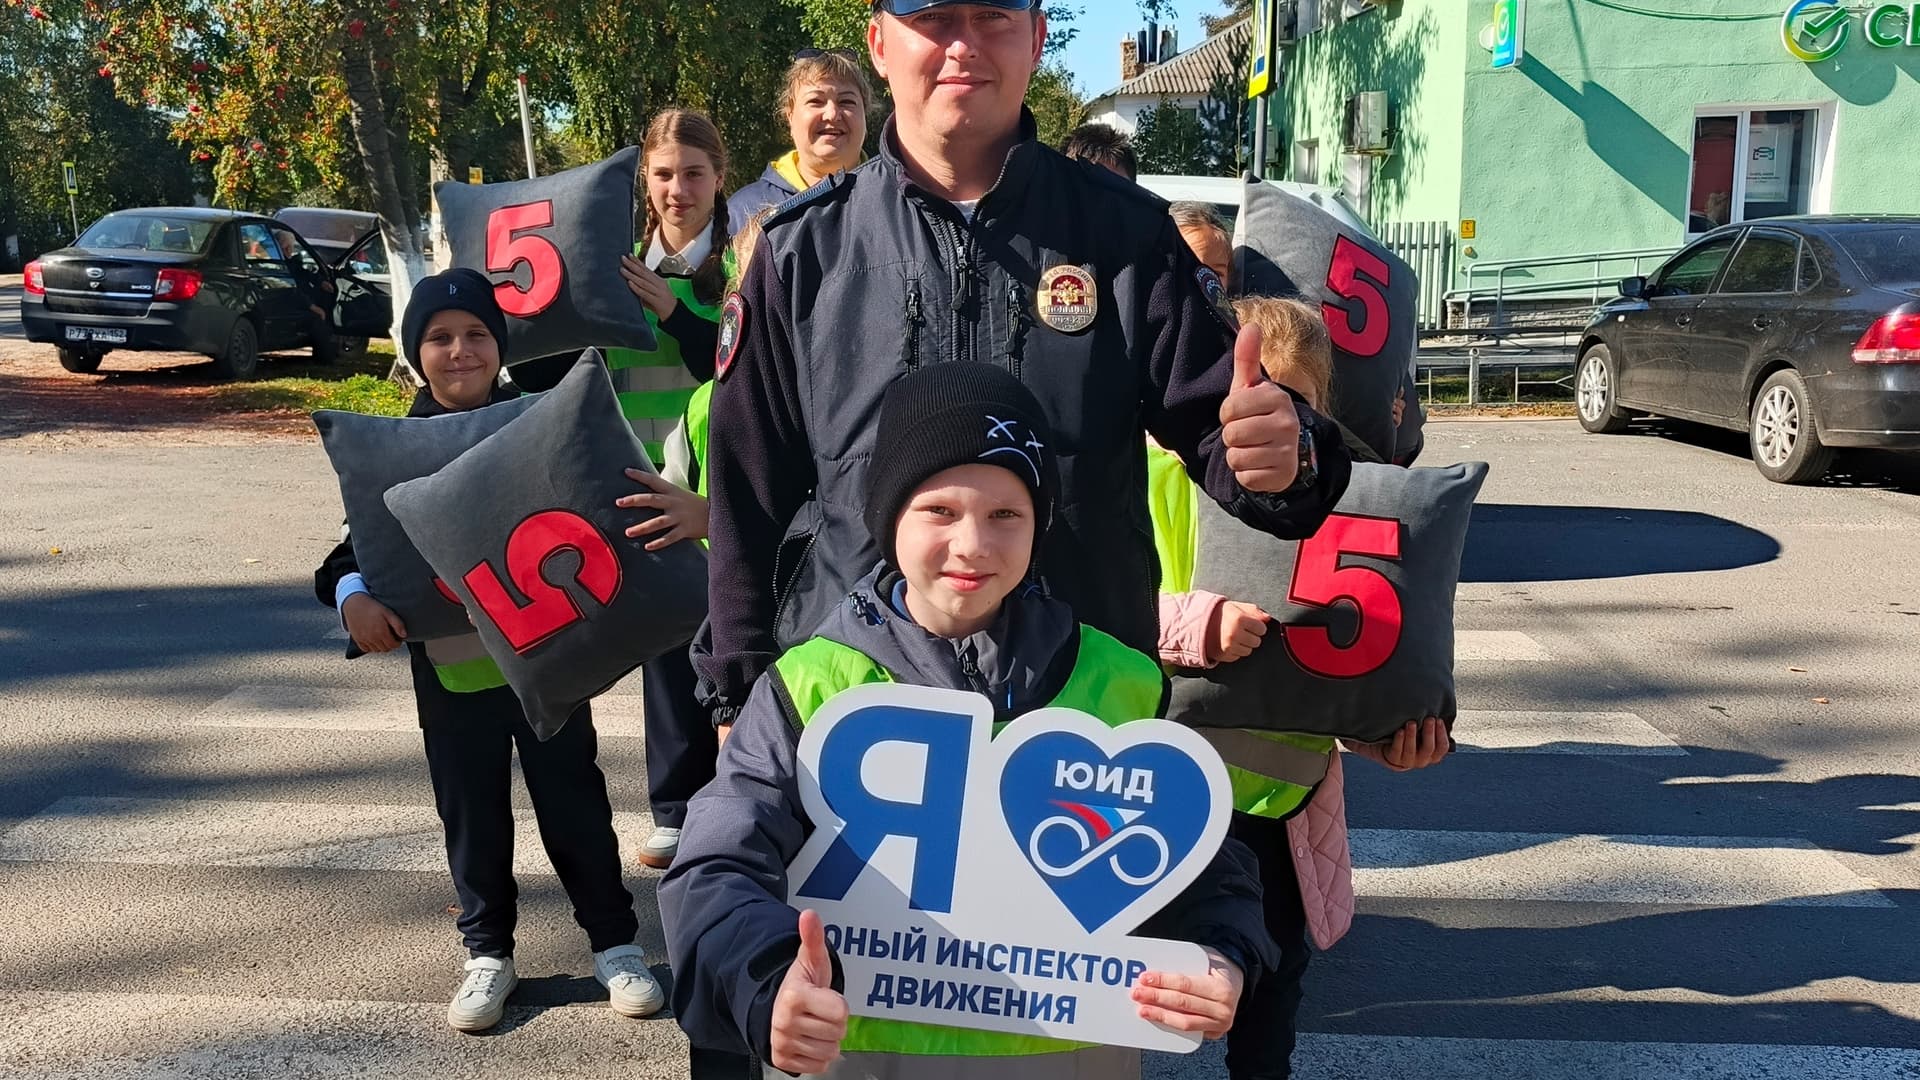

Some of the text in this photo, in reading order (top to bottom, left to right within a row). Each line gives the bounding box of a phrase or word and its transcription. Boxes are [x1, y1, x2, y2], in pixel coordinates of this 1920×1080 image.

[486, 199, 564, 319] 5
[1321, 233, 1390, 358] 5
[462, 507, 623, 655] 5
[1281, 513, 1402, 679] 5
[796, 705, 1154, 914] Я ЮИД
[867, 973, 1077, 1025] ДВИЖЕНИЯ
[935, 937, 1147, 988] ИНСПЕКТОР
